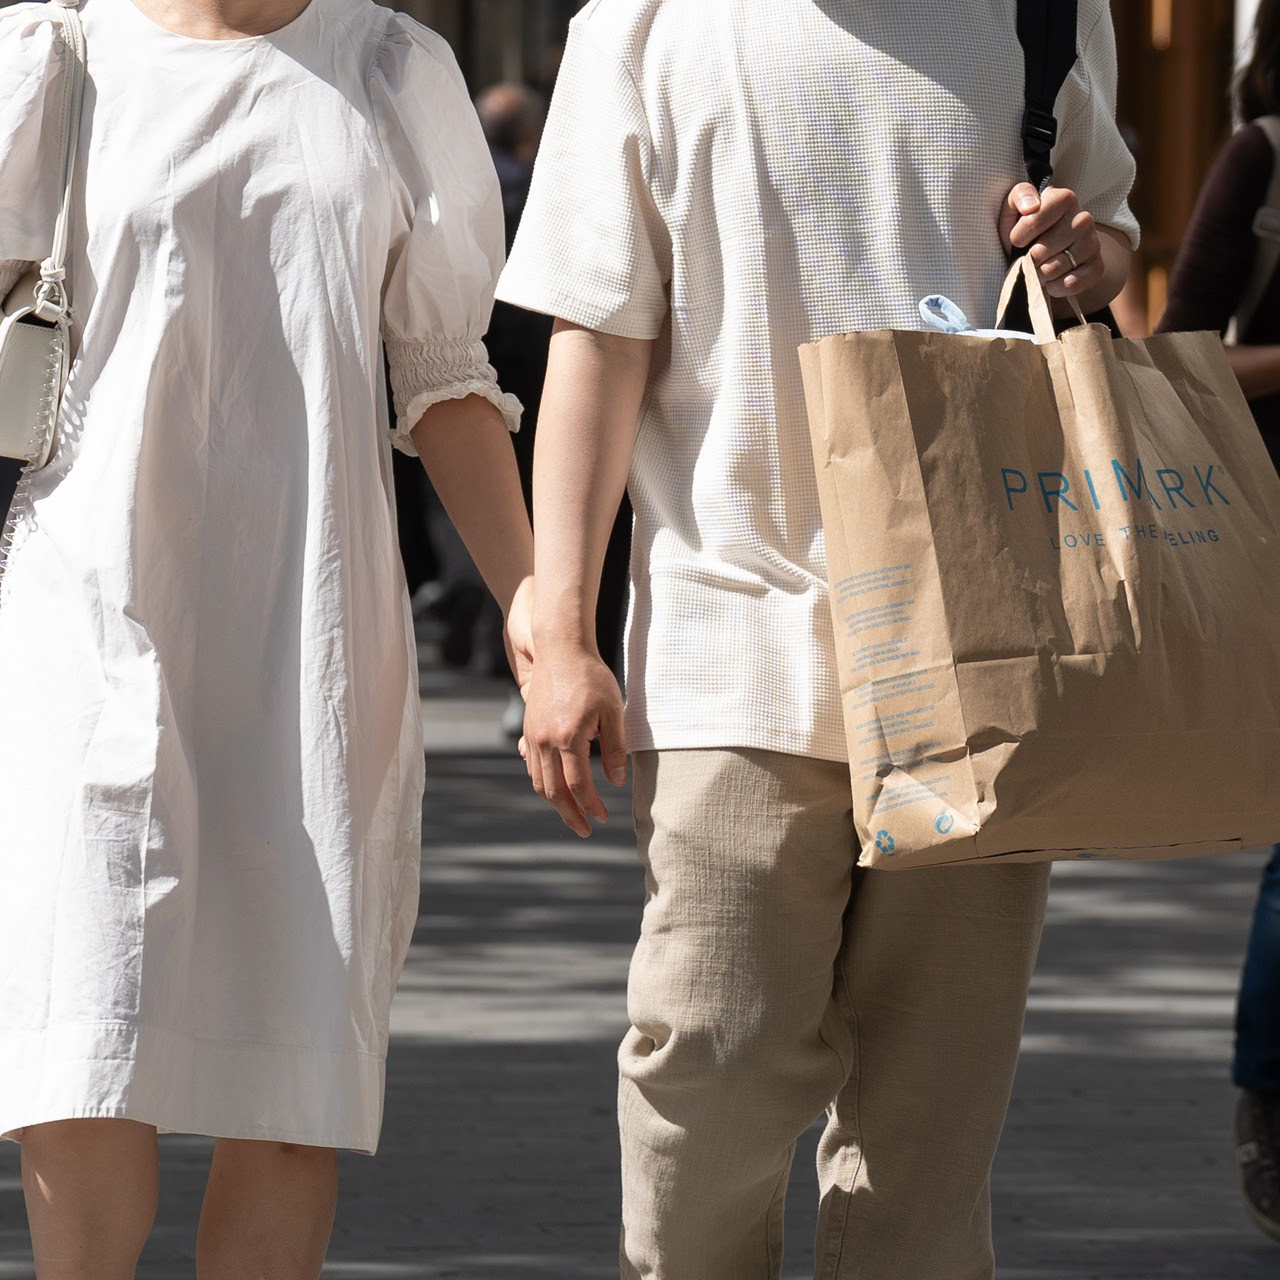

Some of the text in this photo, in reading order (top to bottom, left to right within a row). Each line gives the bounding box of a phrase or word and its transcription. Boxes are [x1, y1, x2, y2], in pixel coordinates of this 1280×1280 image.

[1000, 457, 1231, 513] PRIMRK
[1050, 533, 1106, 550] LOVE
[1119, 524, 1158, 540] THE
